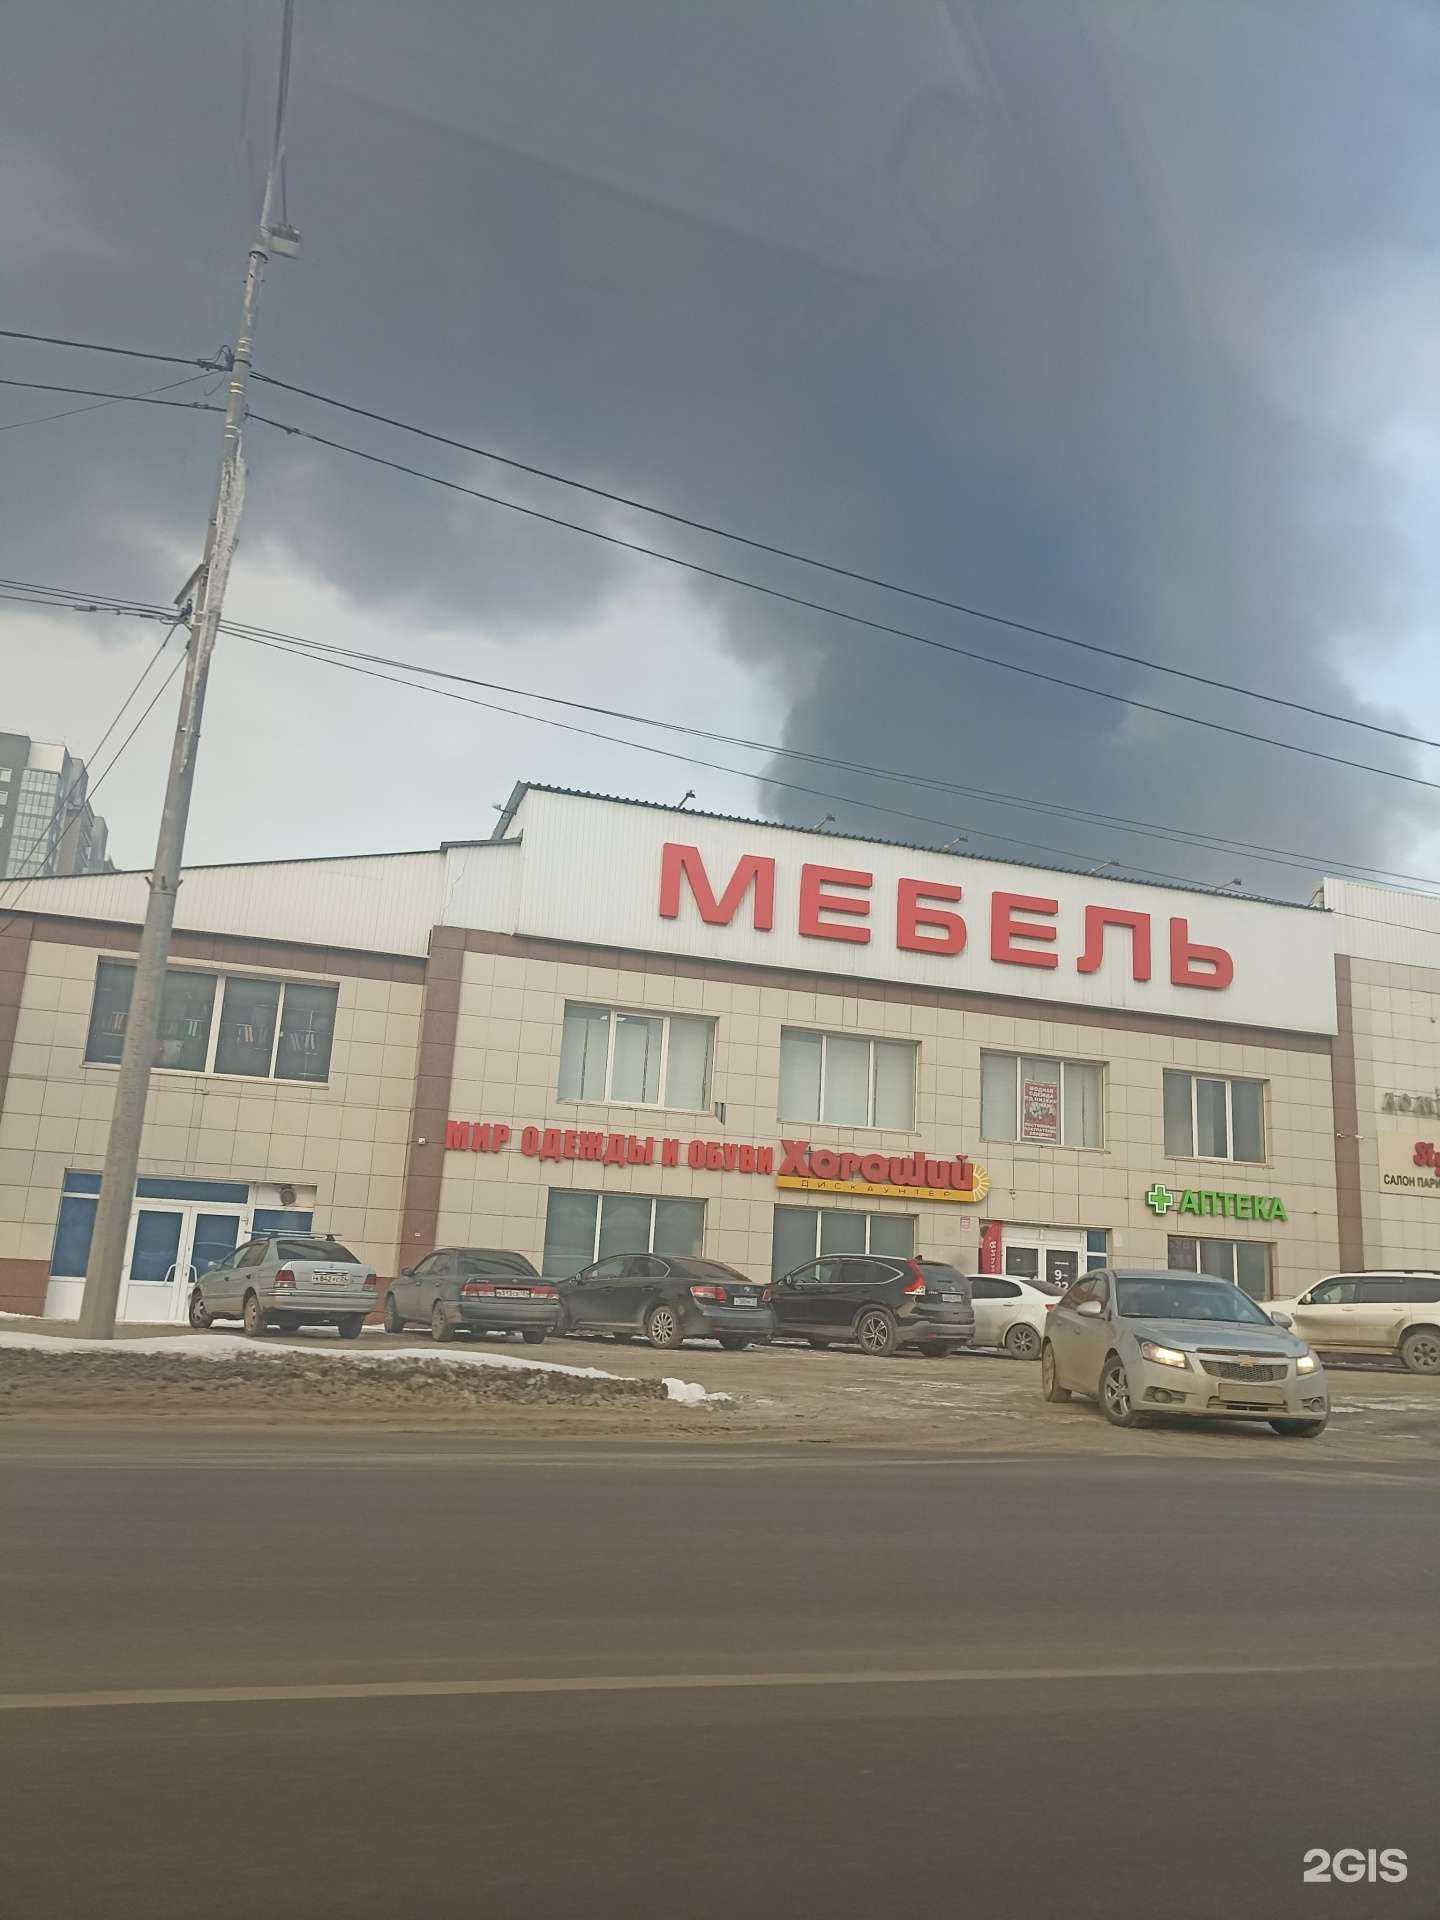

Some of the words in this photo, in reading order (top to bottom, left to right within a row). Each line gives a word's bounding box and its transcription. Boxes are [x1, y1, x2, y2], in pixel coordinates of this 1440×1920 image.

[659, 842, 1234, 990] МЕБЕЛЬ
[445, 1120, 510, 1154] МИР
[521, 1126, 654, 1169] ОДЕЖДЫ
[662, 1137, 680, 1168] И
[687, 1139, 774, 1176] ОБУВИ
[779, 1140, 975, 1192] Хороший
[801, 1179, 951, 1197] ДИСКАУНТЕР
[1383, 1174, 1415, 1187] САЛОН
[1180, 1189, 1287, 1222] АПТЕКА
